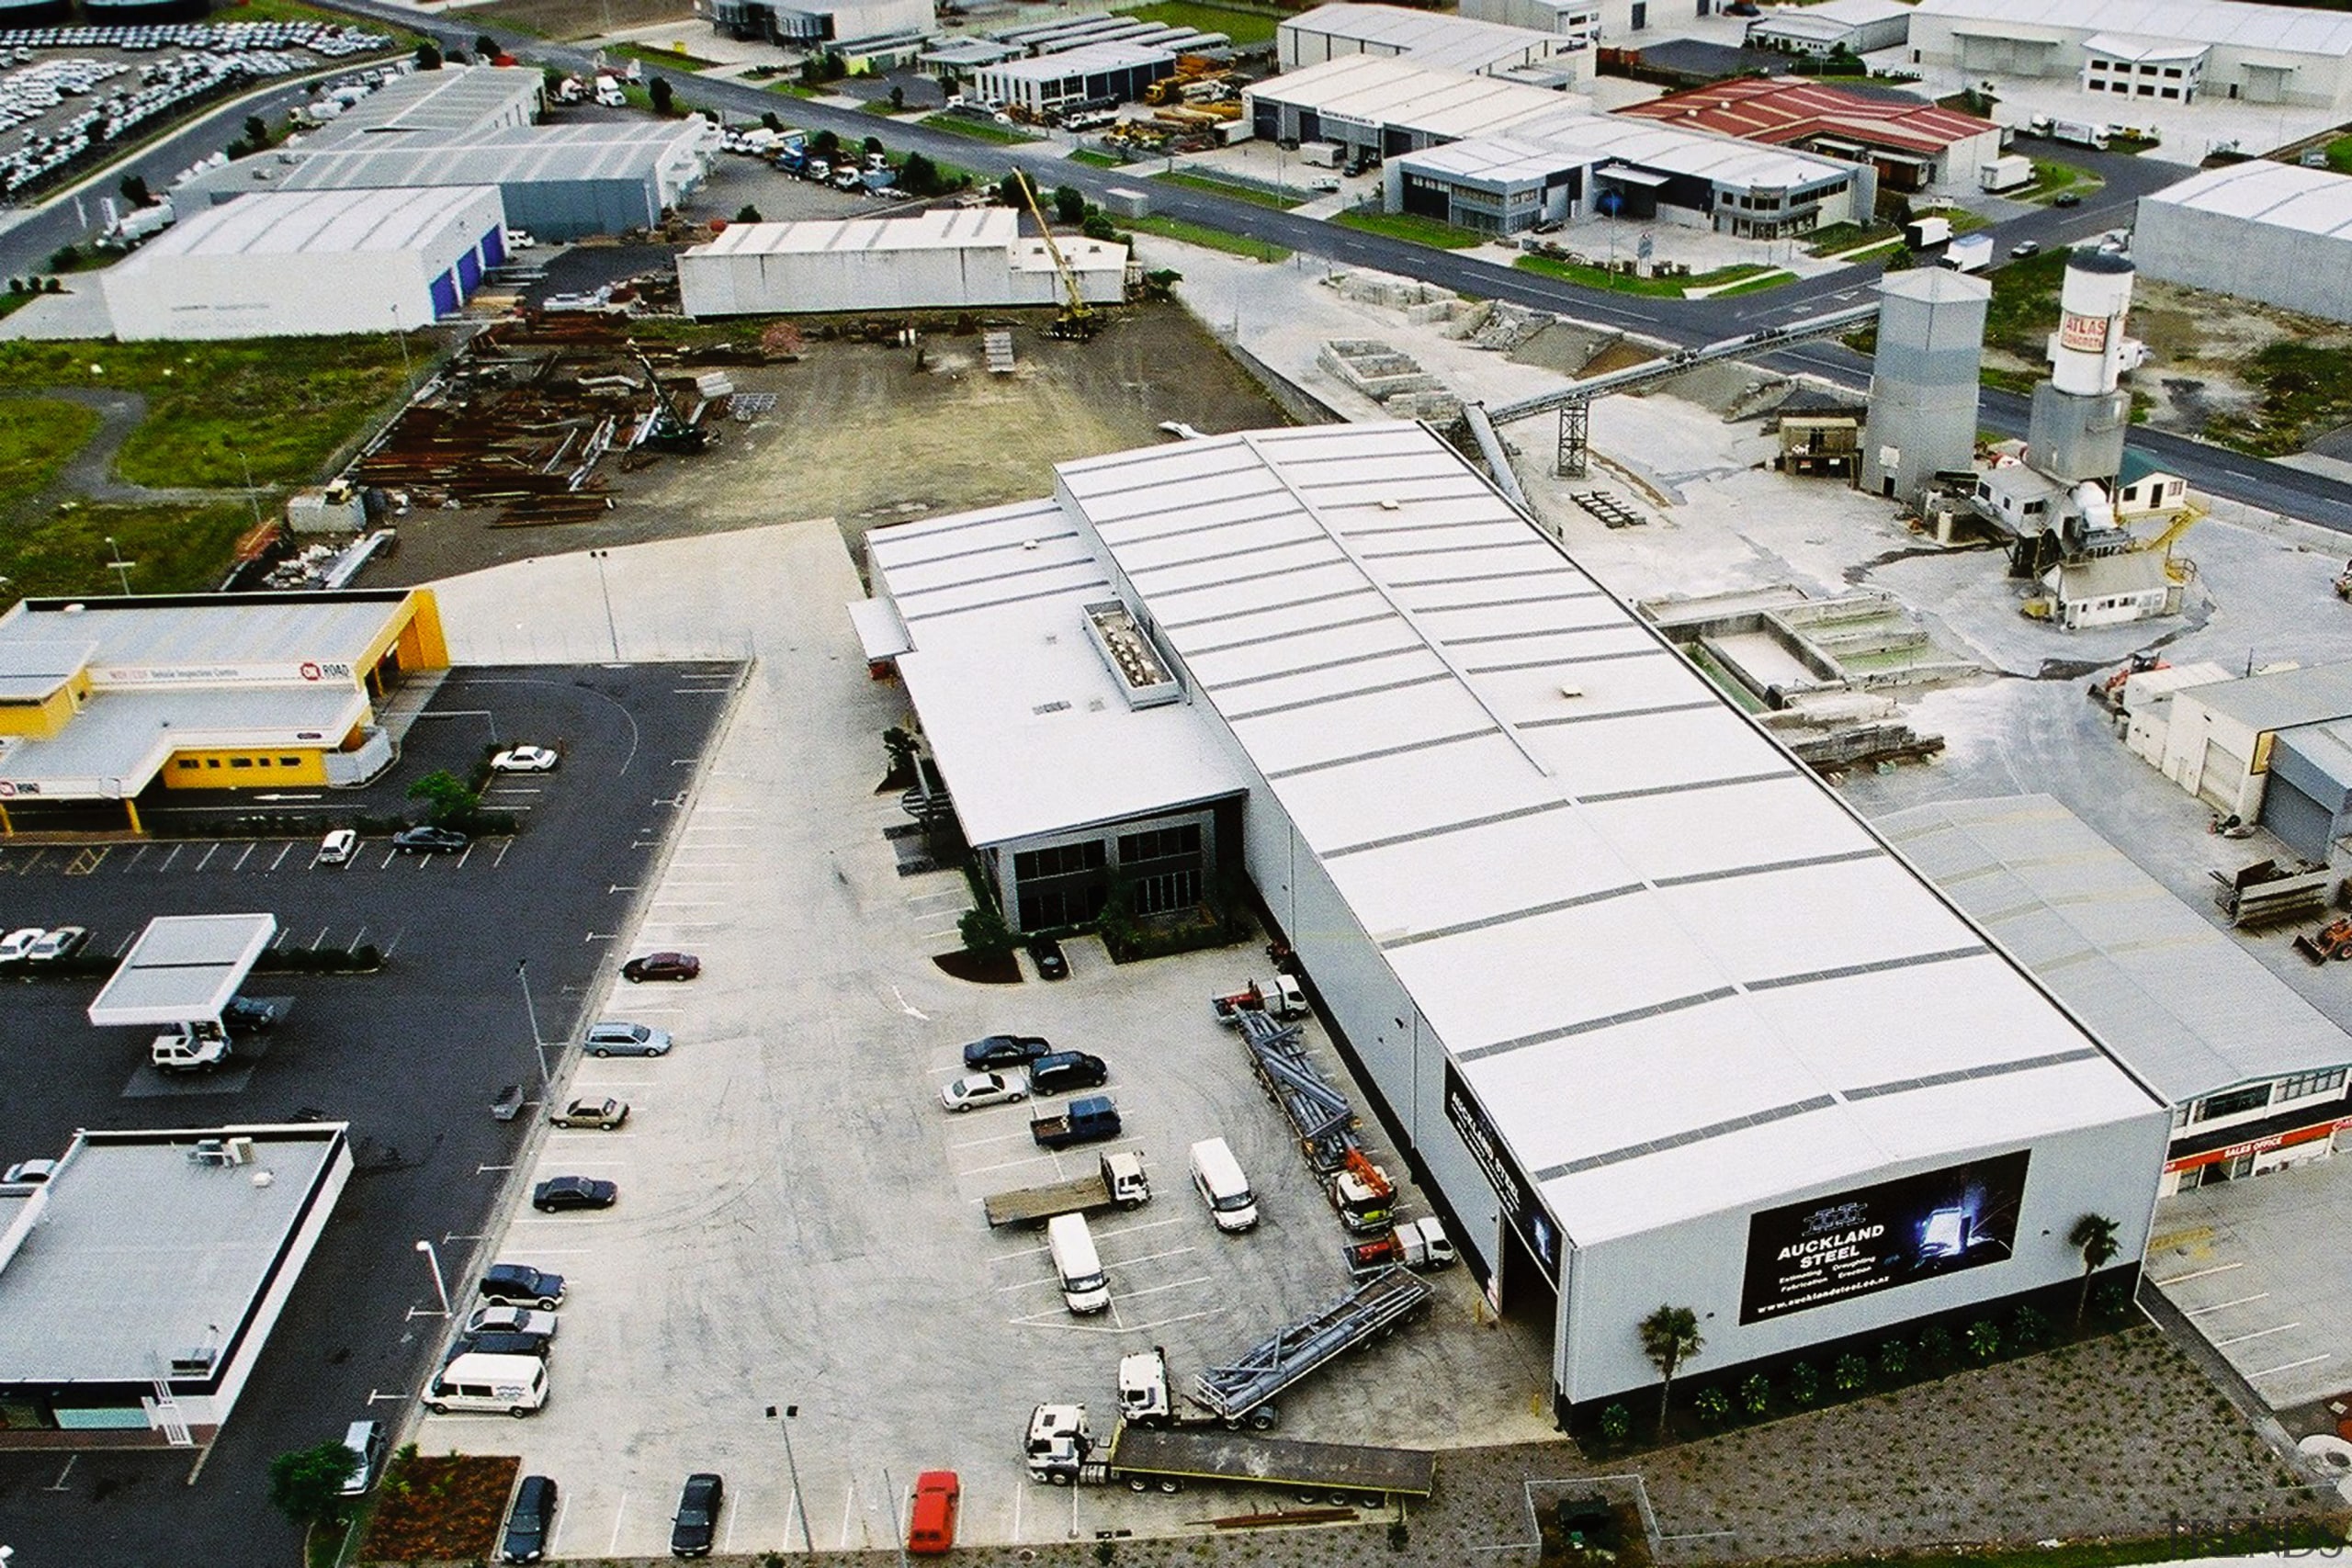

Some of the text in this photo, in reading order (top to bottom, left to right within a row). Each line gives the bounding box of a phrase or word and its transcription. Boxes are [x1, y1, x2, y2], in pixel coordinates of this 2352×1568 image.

[2066, 317, 2105, 335] ATLAS
[322, 663, 349, 678] ROAD
[2224, 1137, 2282, 1158] SALES OFFICE
[1777, 1225, 1884, 1261] AUCKLAND
[1800, 1245, 1860, 1269] STEEL
[1779, 1256, 1876, 1284] Estimating Draughting
[1781, 1266, 1872, 1292] Fabrication Erection
[1758, 1276, 1890, 1314] www.aucklandsteel.co.nz
